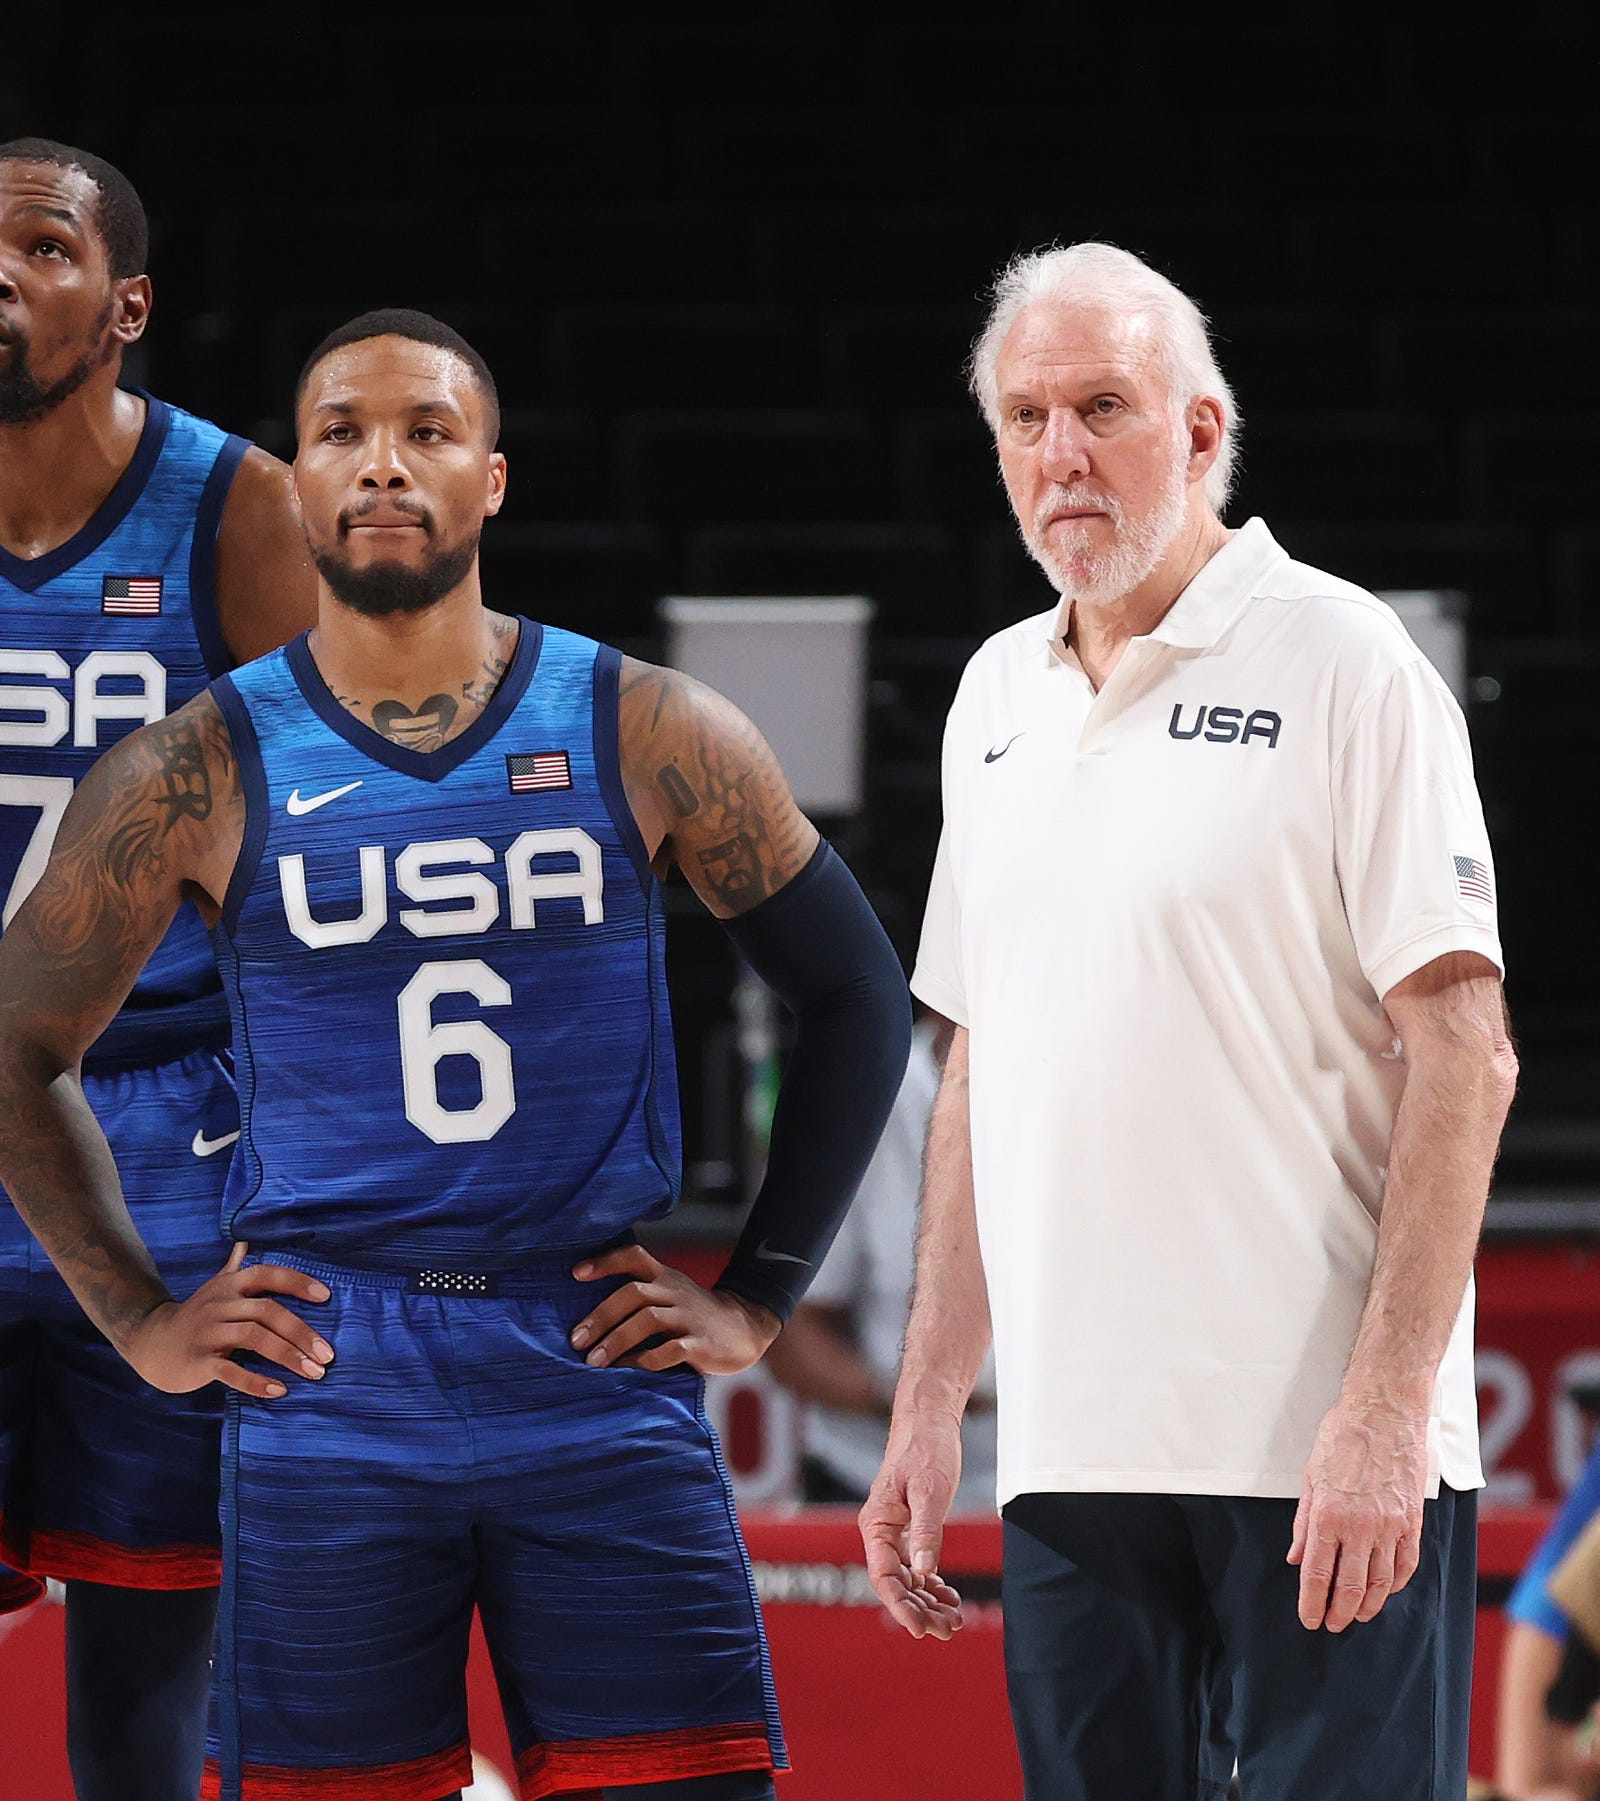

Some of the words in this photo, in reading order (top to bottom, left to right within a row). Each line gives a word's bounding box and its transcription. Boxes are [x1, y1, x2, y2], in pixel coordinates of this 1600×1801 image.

[1168, 703, 1281, 749] USA
[278, 827, 604, 949] USA
[397, 959, 517, 1144] 6
